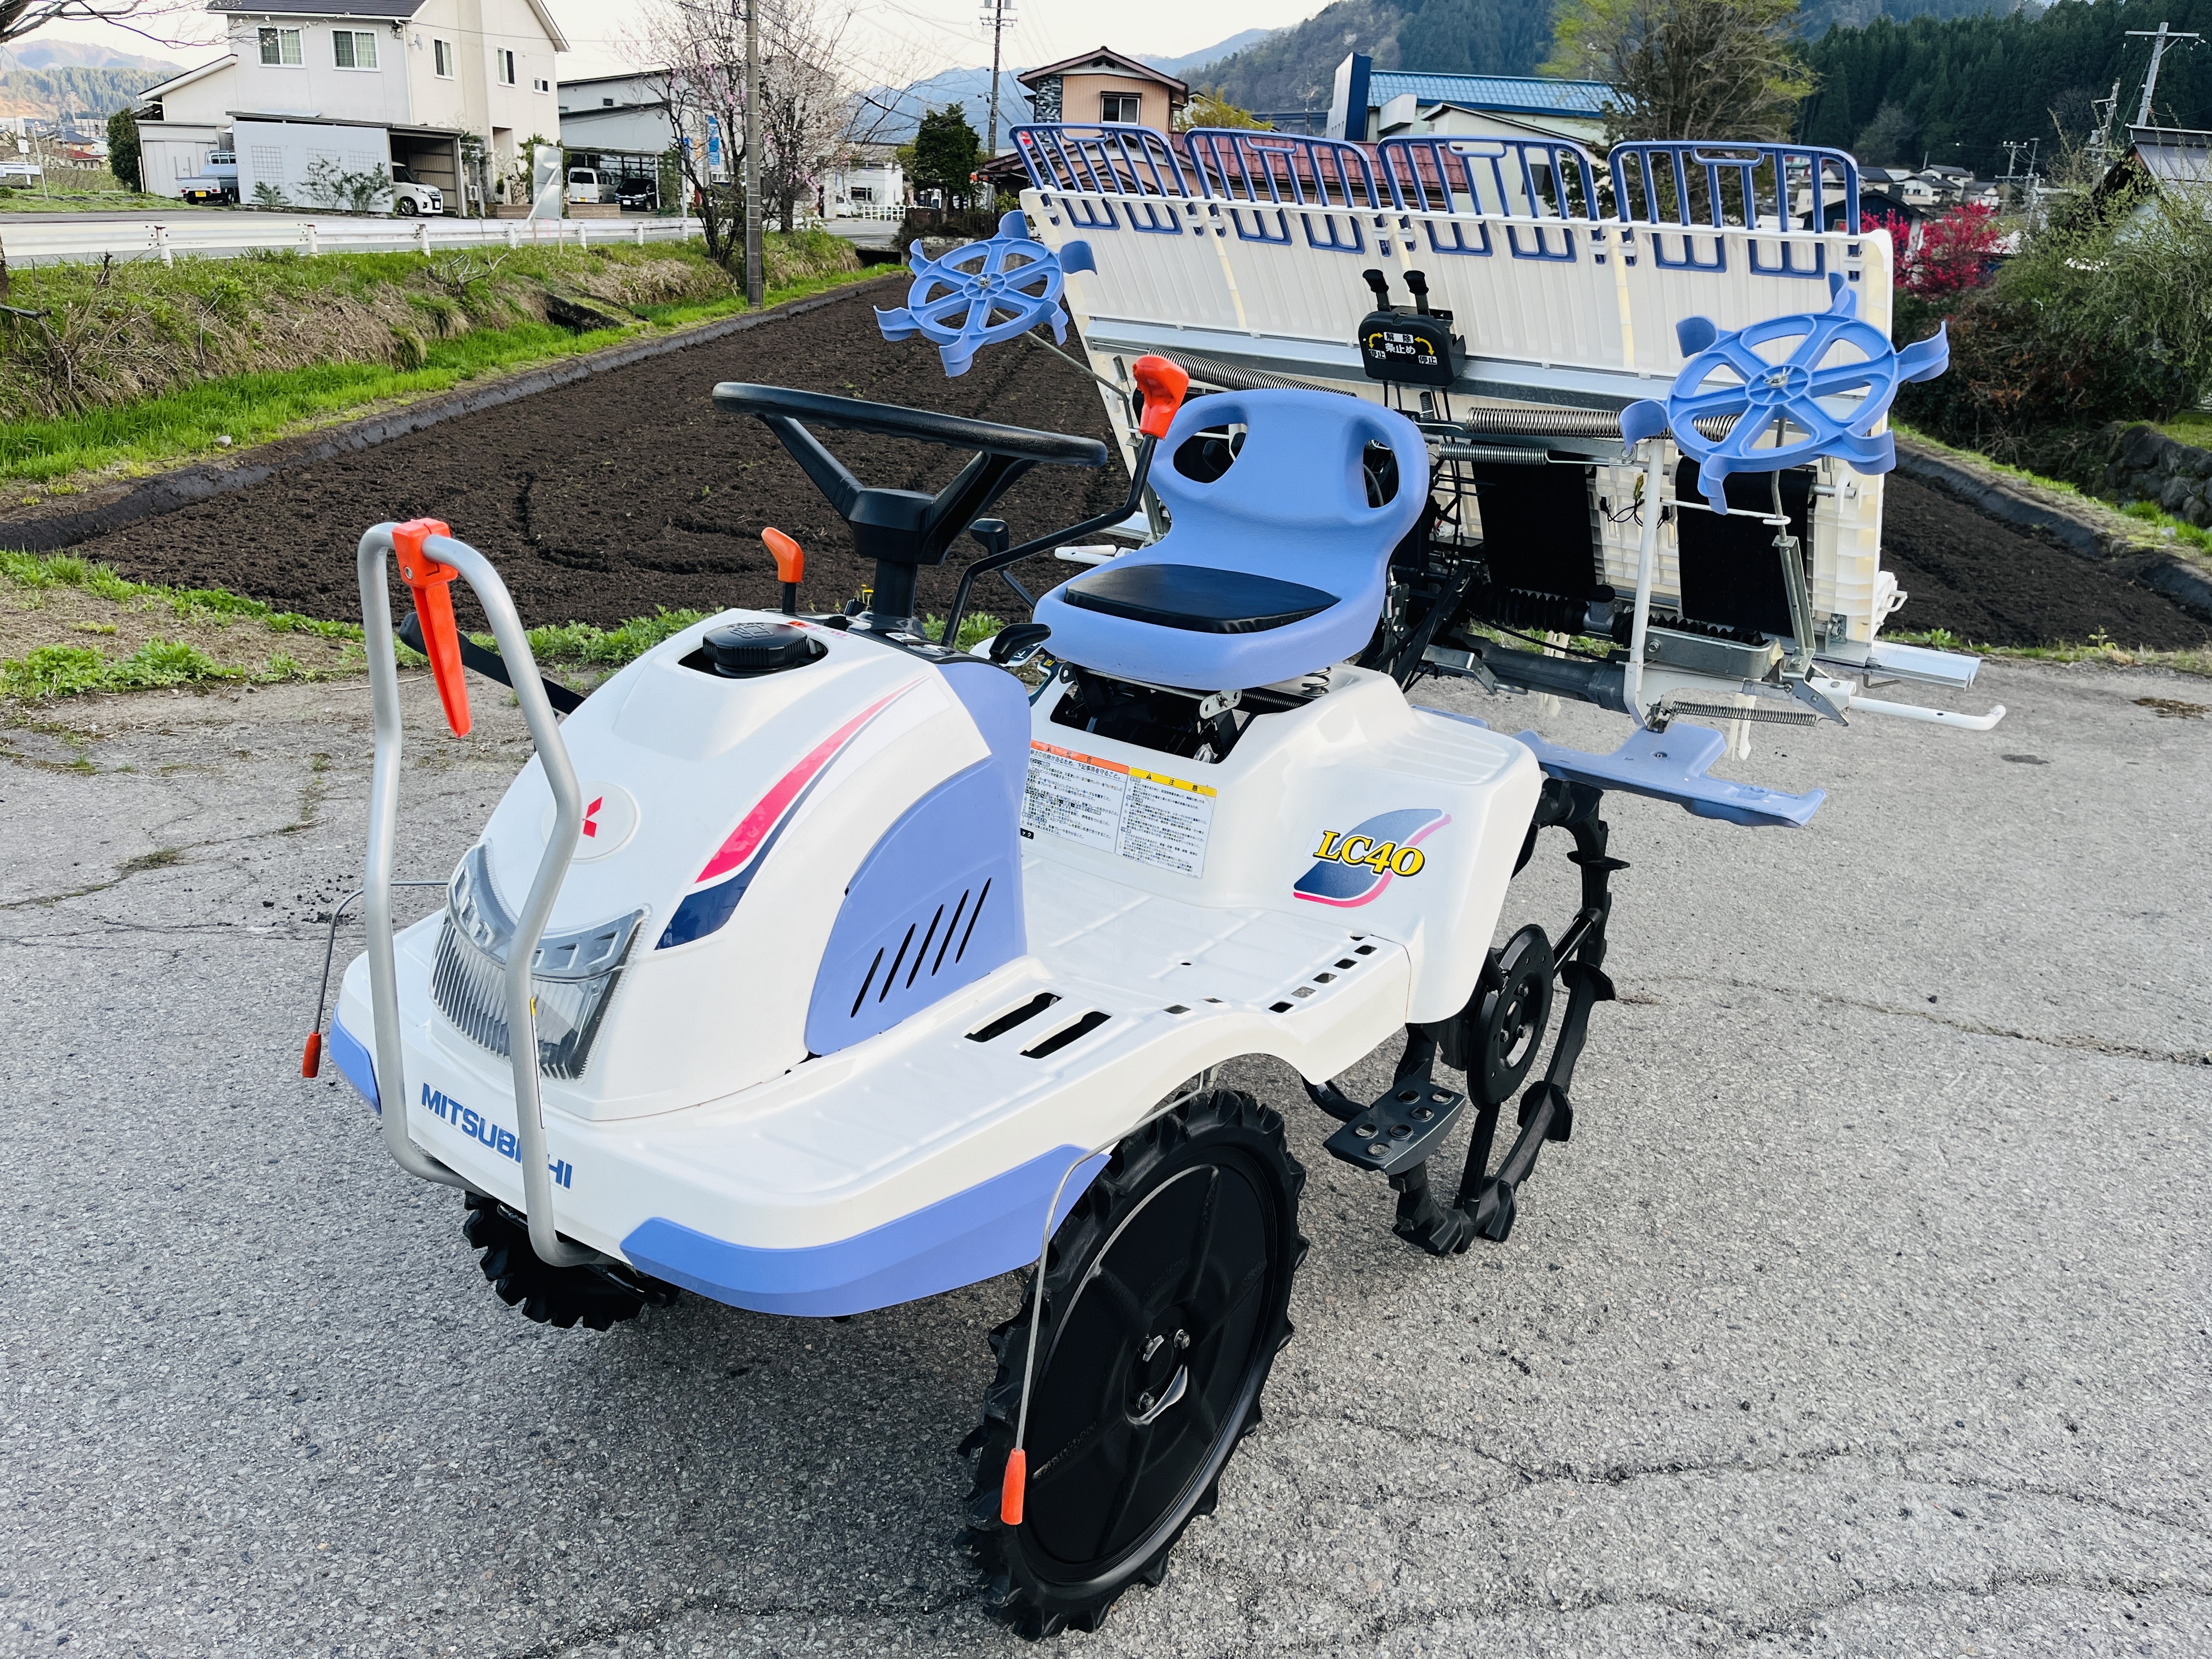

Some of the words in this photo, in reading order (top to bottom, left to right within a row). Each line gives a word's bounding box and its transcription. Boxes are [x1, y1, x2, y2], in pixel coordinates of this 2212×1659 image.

[1386, 332, 1412, 343] 解除
[1420, 356, 1437, 364] 停止
[1169, 778, 1198, 792] 注意
[1313, 830, 1425, 877] LC40
[421, 1082, 573, 1189] MITSUBIHI
